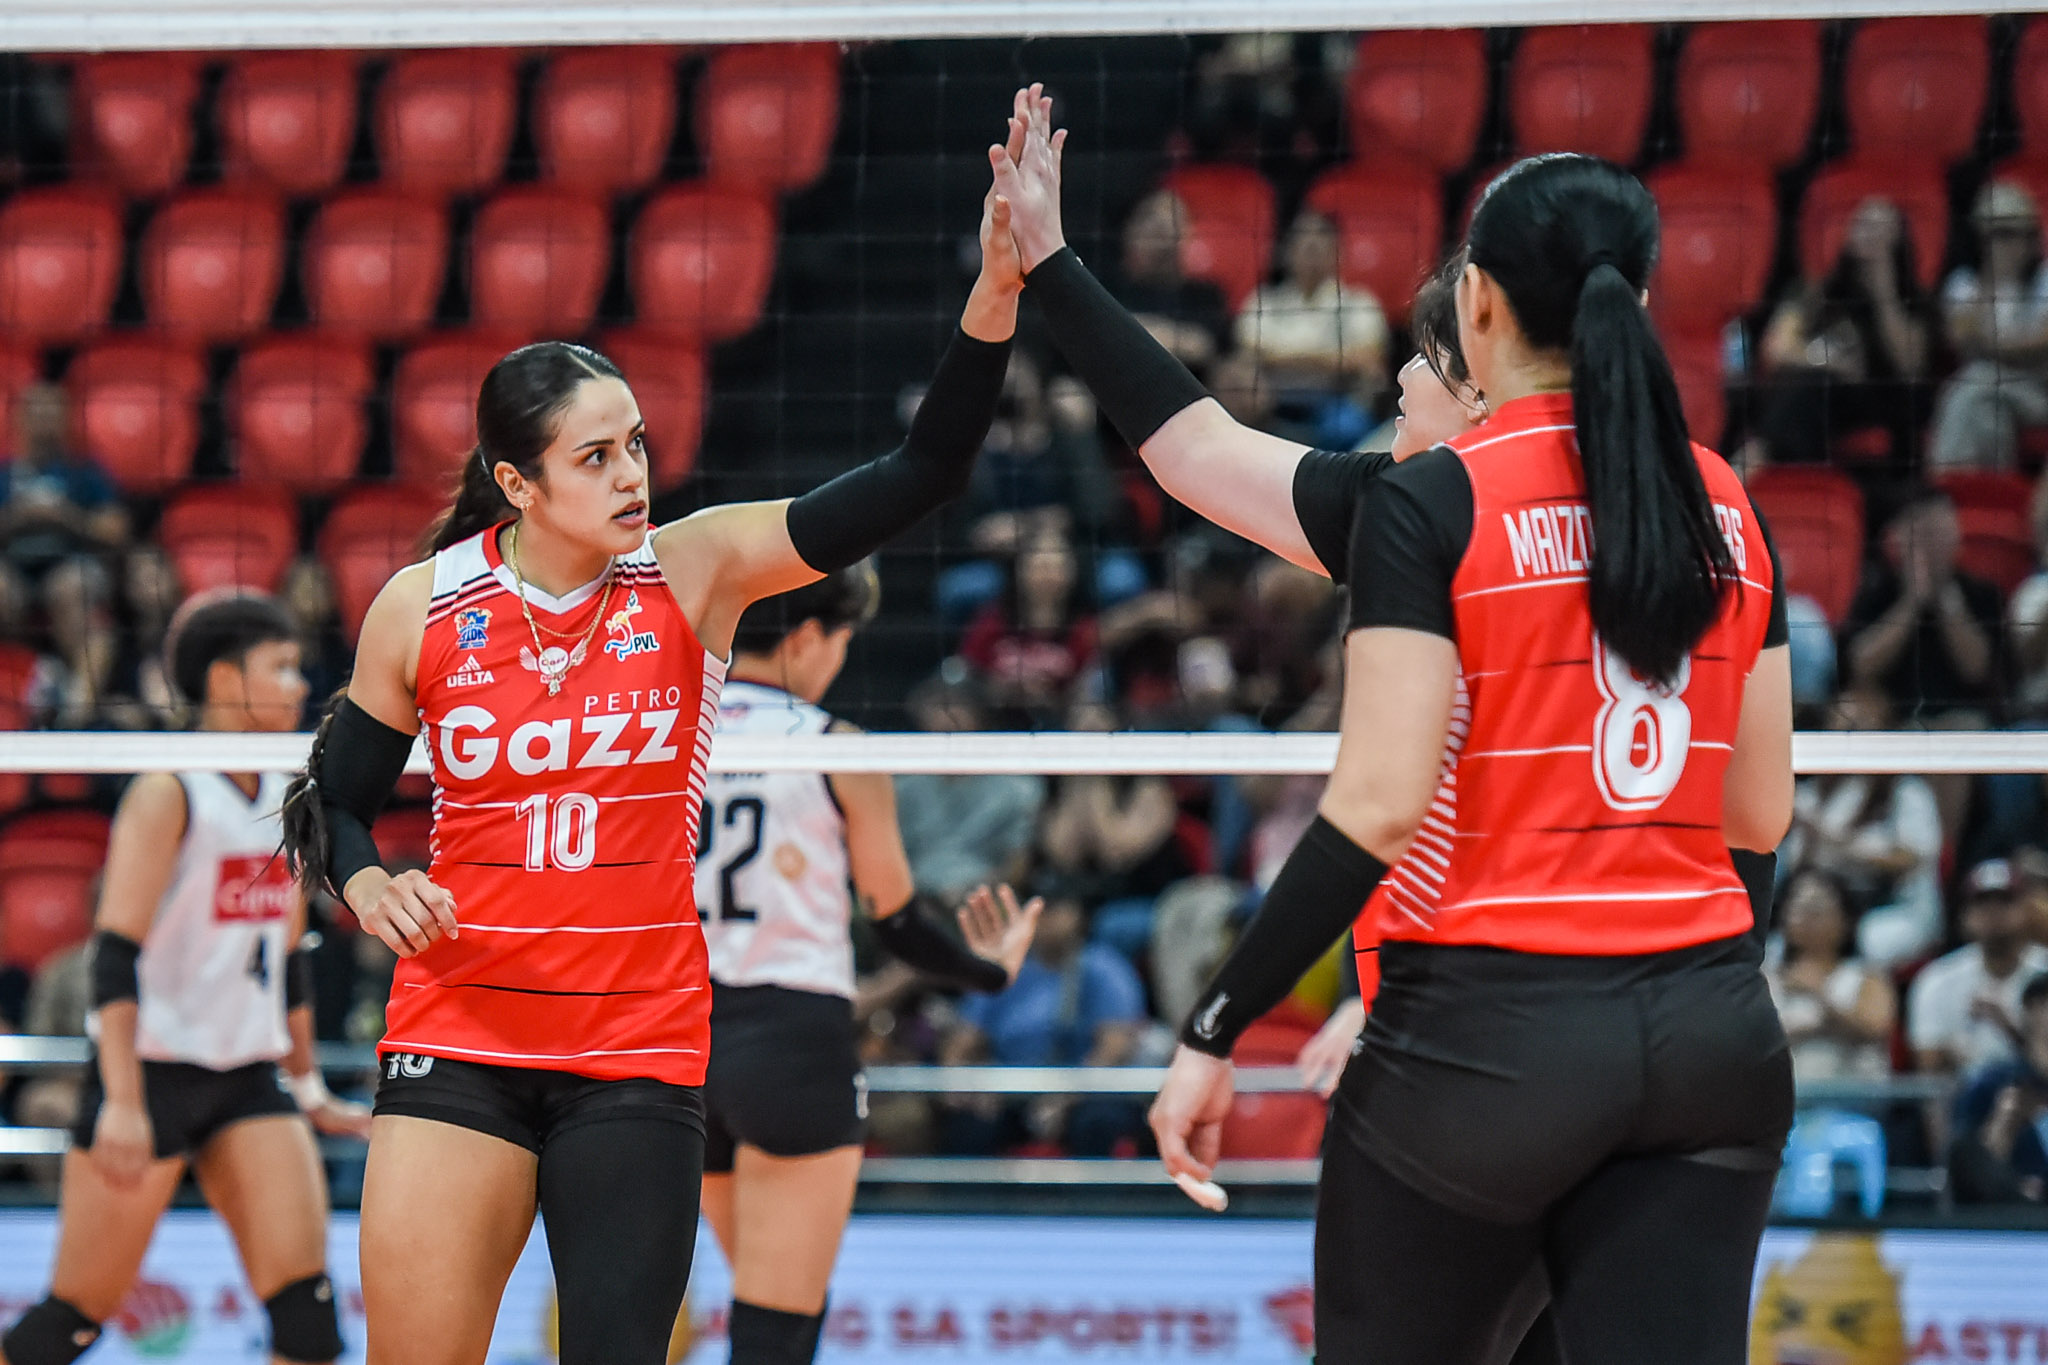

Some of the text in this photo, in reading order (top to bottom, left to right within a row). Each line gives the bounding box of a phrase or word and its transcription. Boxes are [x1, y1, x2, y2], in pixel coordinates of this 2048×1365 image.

[633, 634, 658, 651] PVL
[584, 686, 681, 714] PETRO
[1592, 626, 1691, 811] 8
[438, 705, 680, 780] Gazz
[515, 792, 598, 872] 10
